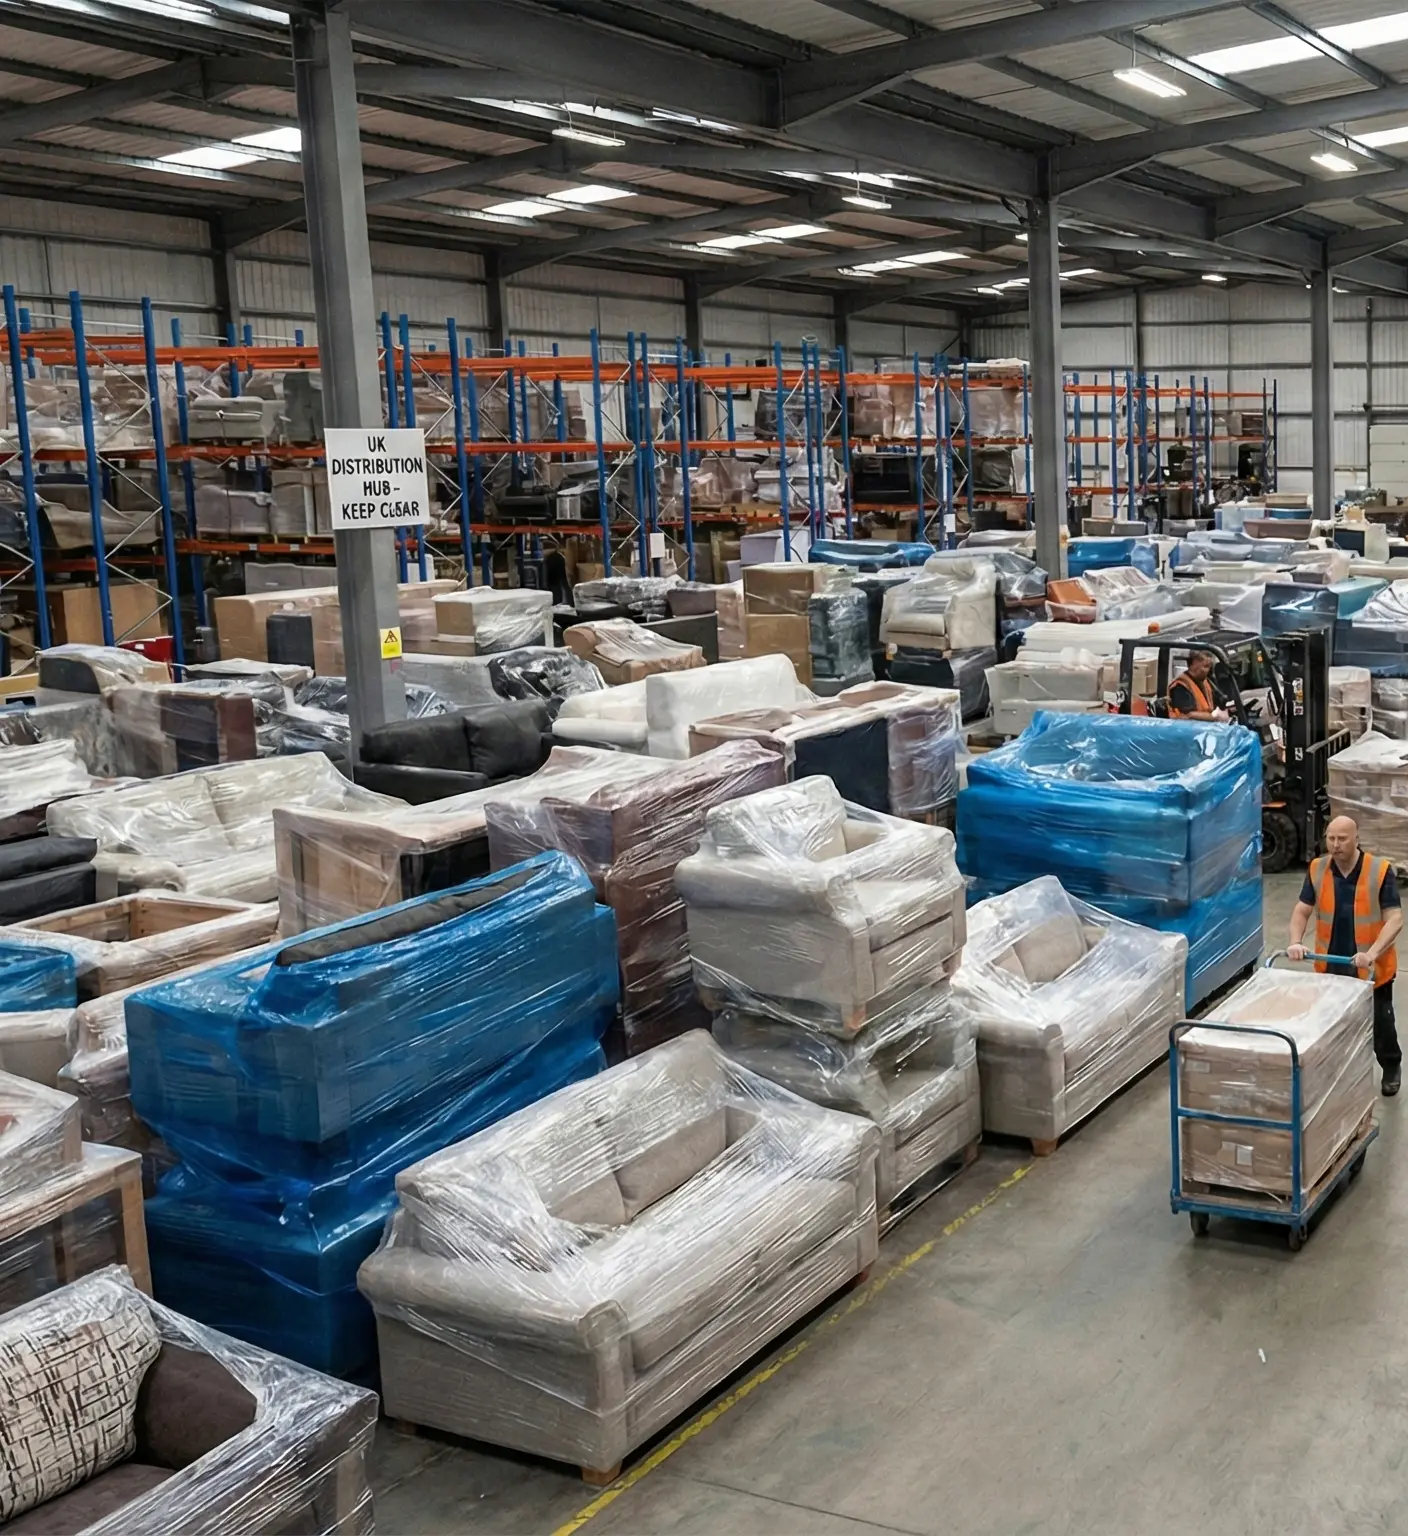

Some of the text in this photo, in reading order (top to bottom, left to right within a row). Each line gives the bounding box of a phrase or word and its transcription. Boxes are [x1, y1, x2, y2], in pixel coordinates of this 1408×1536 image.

[367, 436, 386, 452] UK
[332, 457, 423, 475] DISTRIBUTION
[342, 503, 375, 520] KEEP
